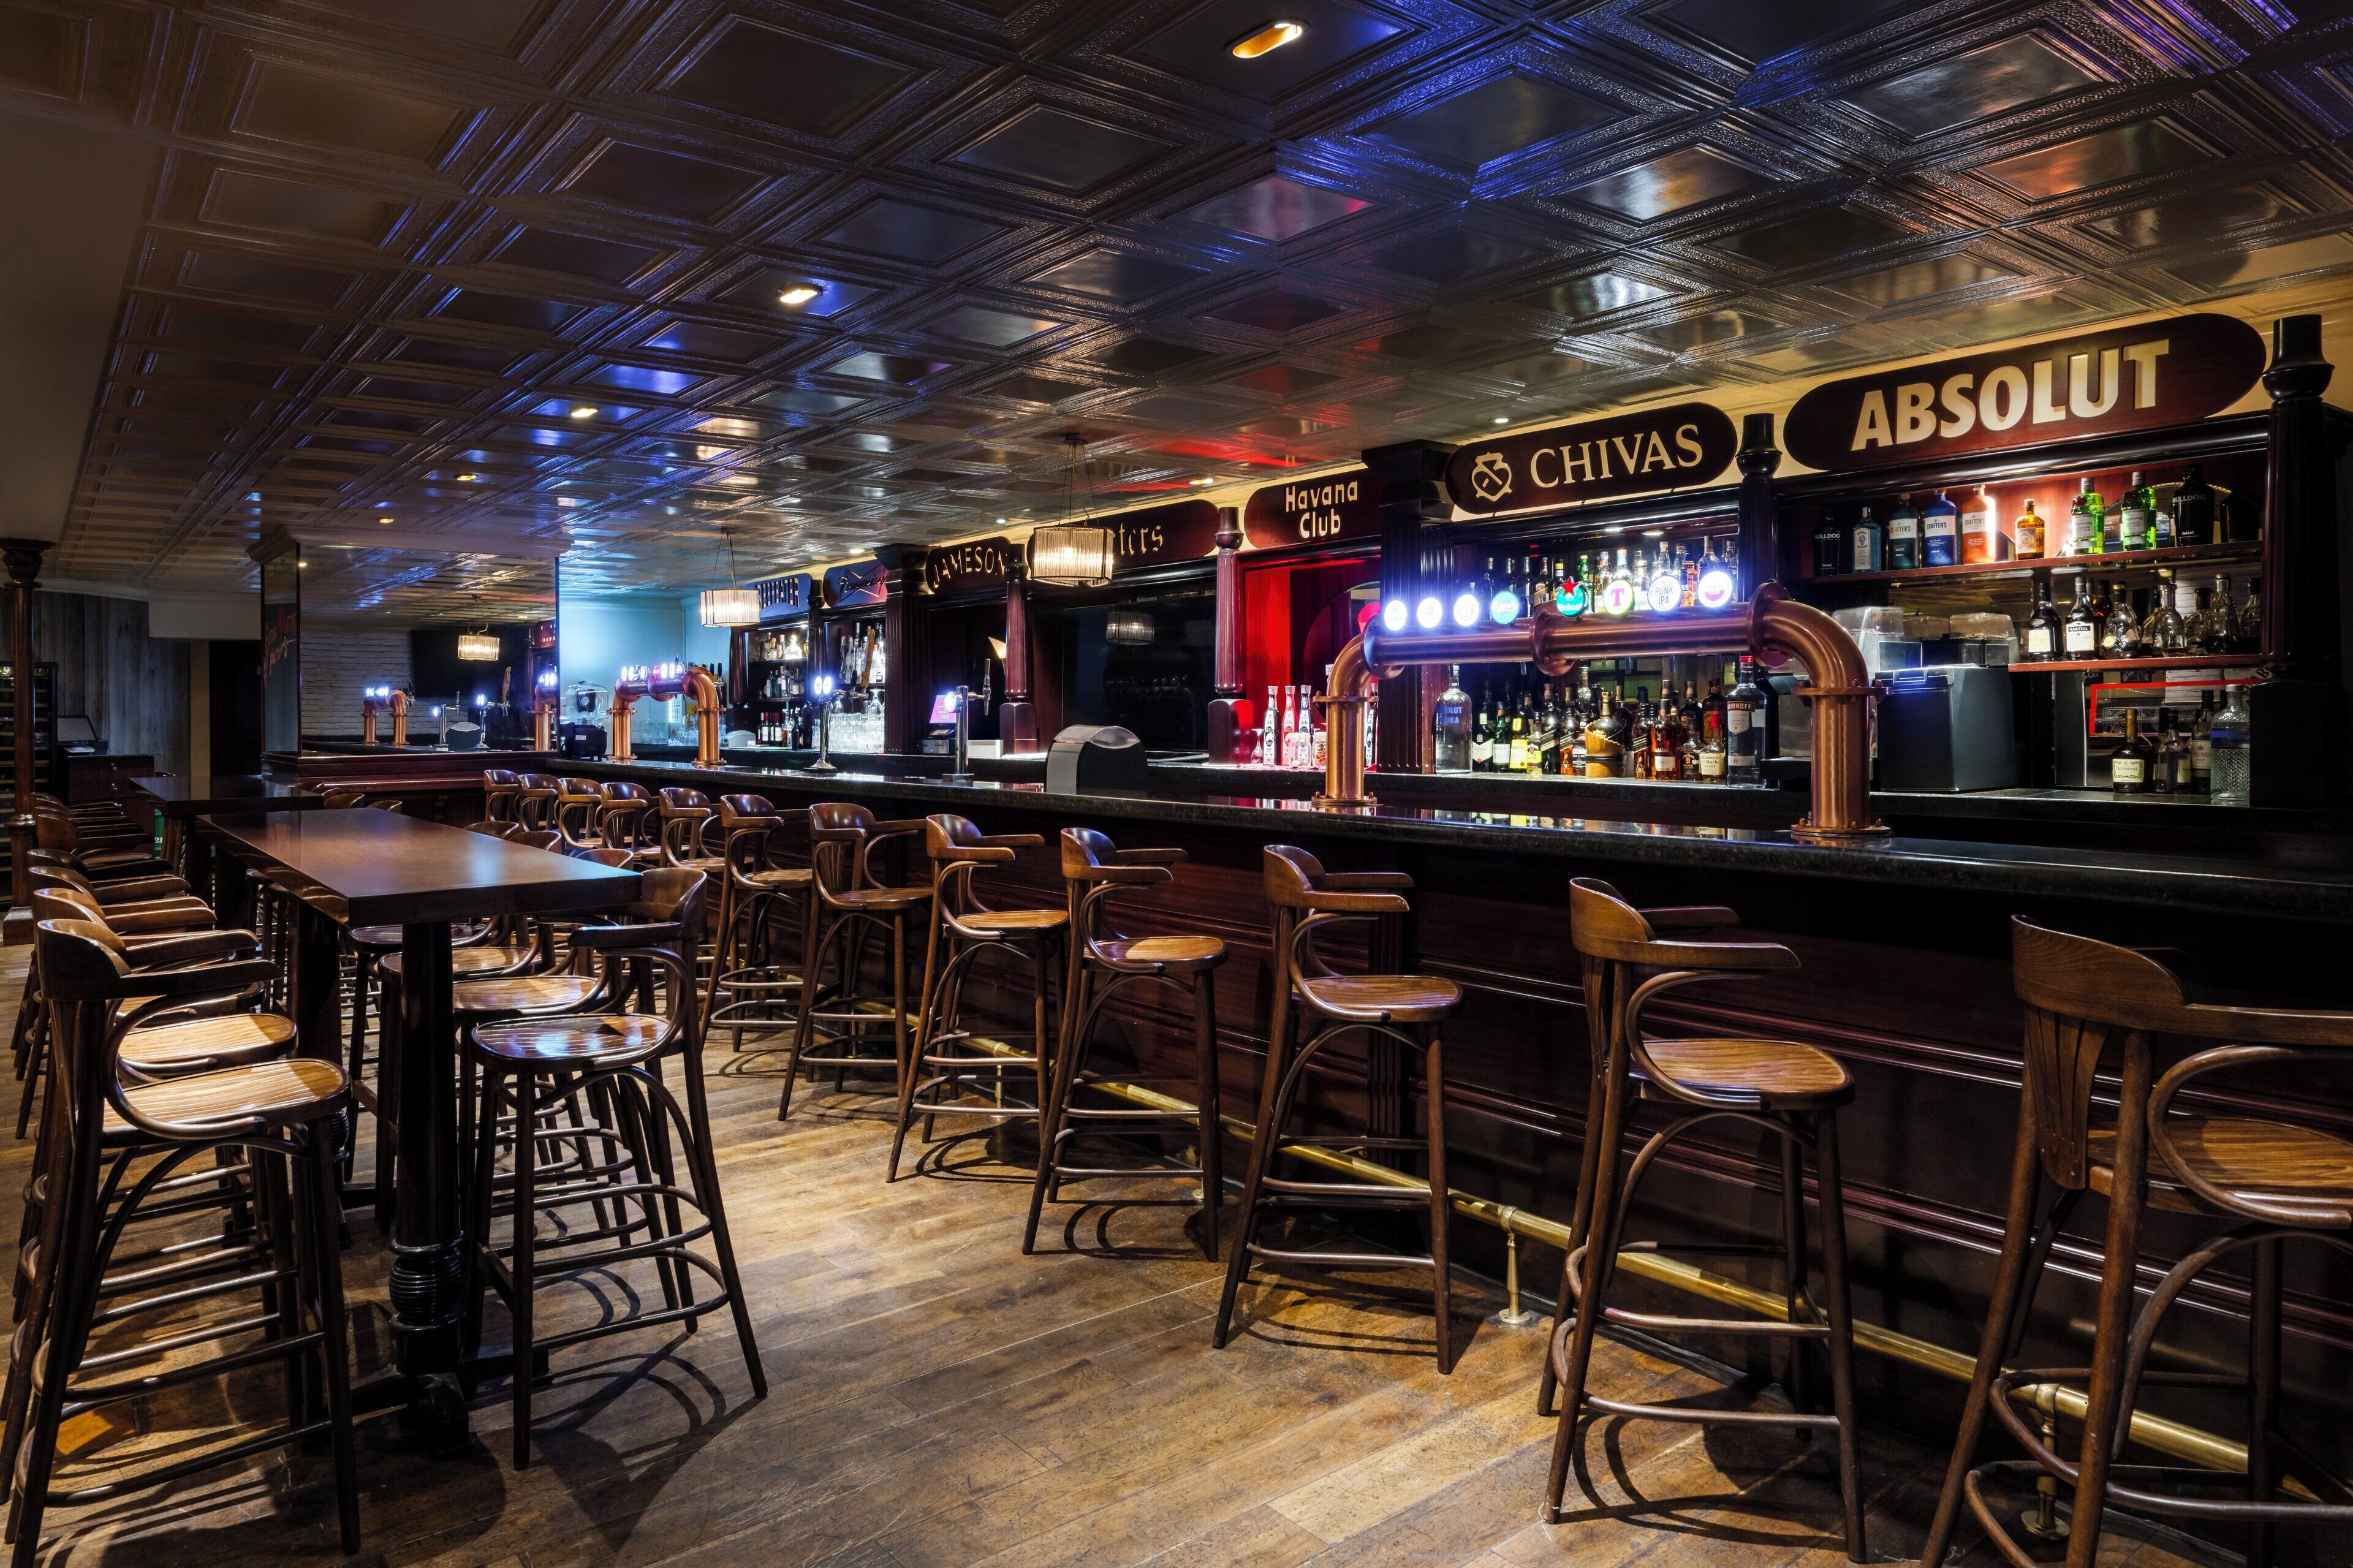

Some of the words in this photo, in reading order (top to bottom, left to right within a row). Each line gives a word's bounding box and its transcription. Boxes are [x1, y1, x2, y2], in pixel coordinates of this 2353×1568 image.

[1850, 338, 2170, 452] ABSOLUT
[1529, 423, 1703, 488] CHIVAS
[1286, 481, 1358, 512] Havana
[2172, 494, 2206, 503] BULLDOG
[1118, 522, 1164, 556] ters
[1300, 508, 1341, 539] Club
[1927, 521, 1947, 530] CRAFTER'S
[933, 545, 1006, 589] JAMESON
[1655, 586, 1673, 596] PUNK
[1658, 595, 1670, 605] IPA
